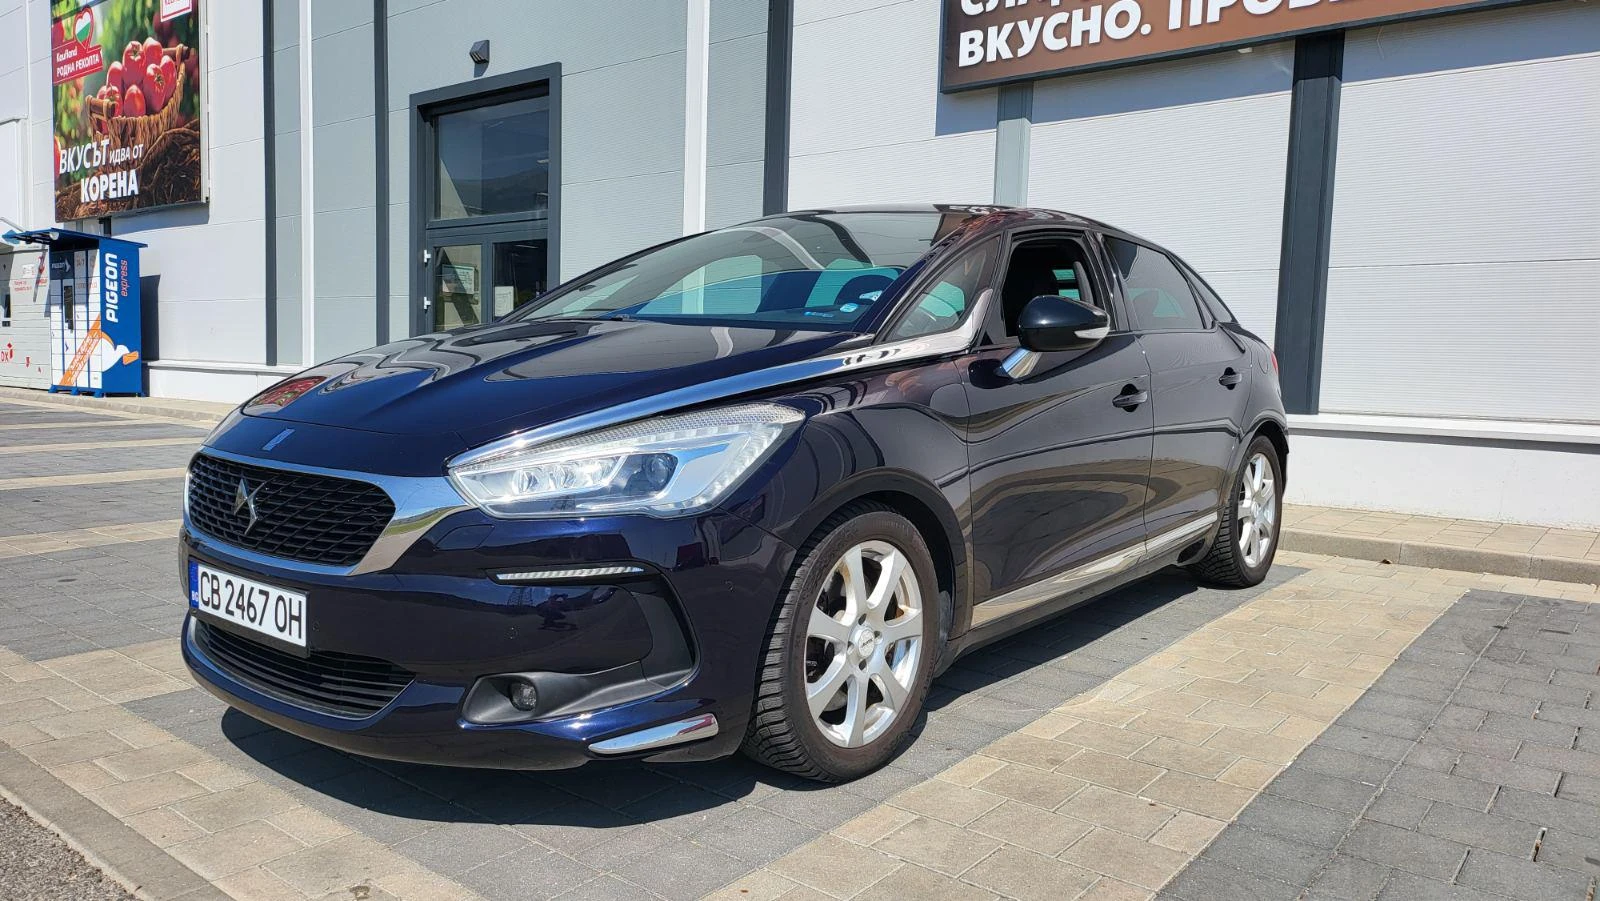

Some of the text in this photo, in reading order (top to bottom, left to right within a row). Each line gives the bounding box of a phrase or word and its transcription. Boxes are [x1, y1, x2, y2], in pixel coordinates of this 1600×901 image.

[958, 0, 1152, 67] ВКУСНО.
[56, 54, 100, 77] РОДНА РЕКОЛТА
[59, 139, 144, 175] ВКУСЪТ ИДВА ОТ
[80, 169, 139, 203] КОРЕНА
[105, 252, 119, 324] PIGEON
[120, 259, 130, 297] express
[200, 571, 302, 640] CB 2467 OH
